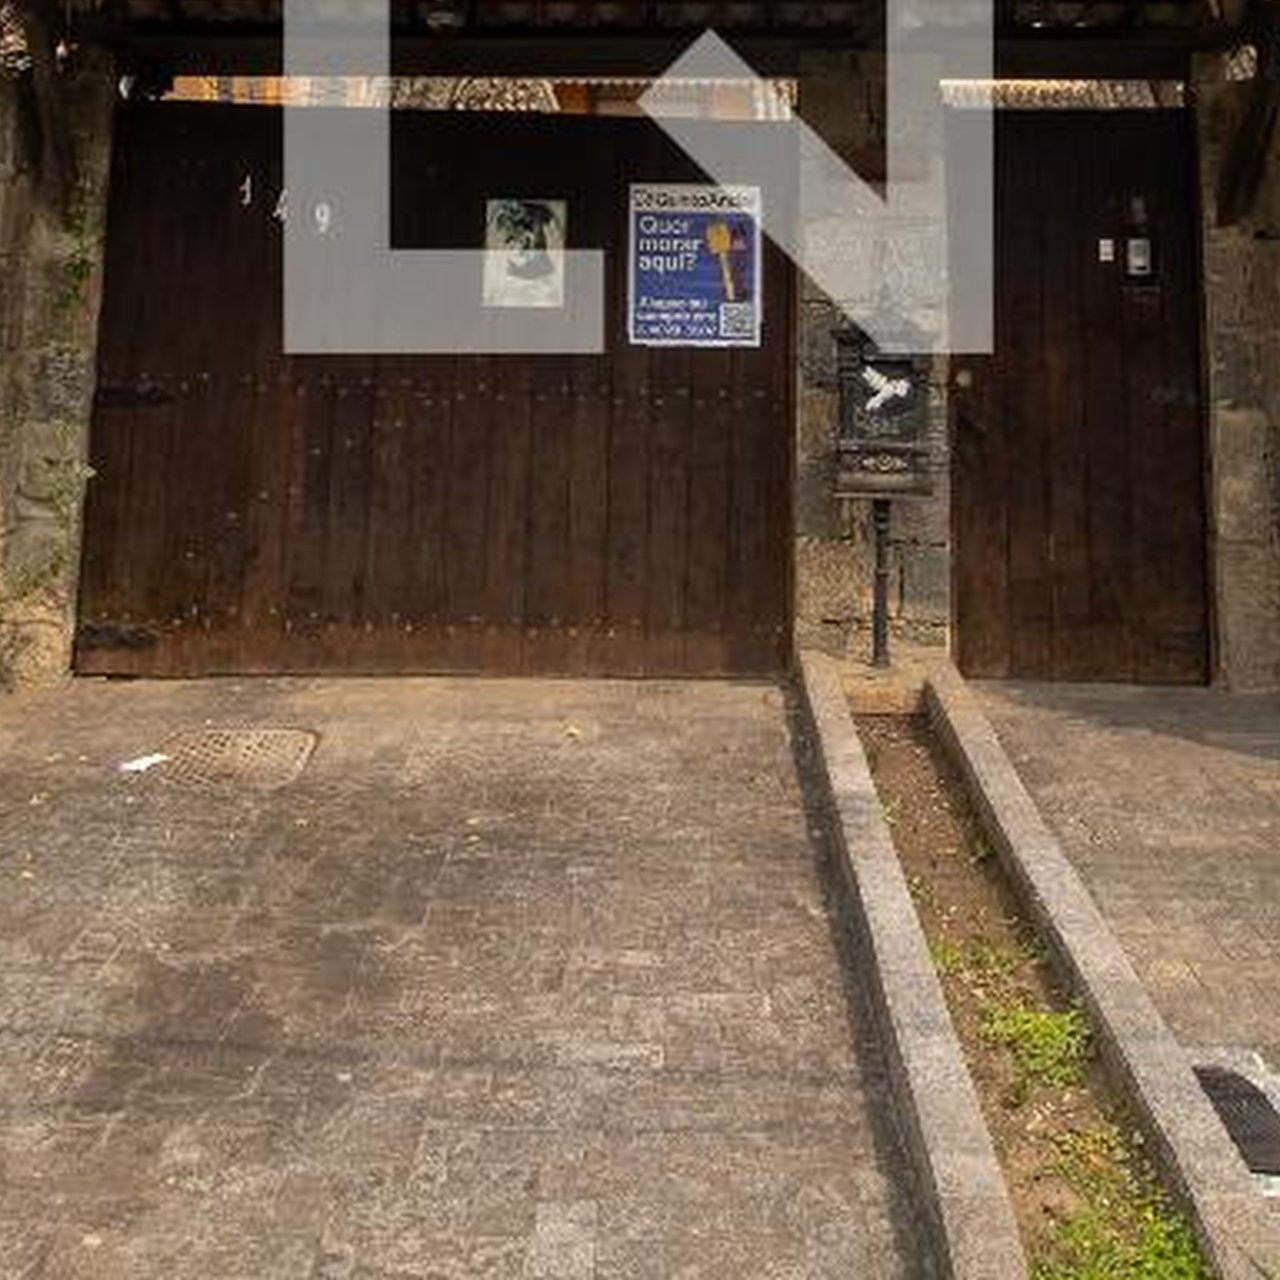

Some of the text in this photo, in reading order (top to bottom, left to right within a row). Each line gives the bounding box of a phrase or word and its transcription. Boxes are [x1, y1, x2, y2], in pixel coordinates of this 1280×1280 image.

[639, 215, 690, 234] Quer
[639, 238, 703, 252] morar
[638, 253, 697, 273] aqui?
